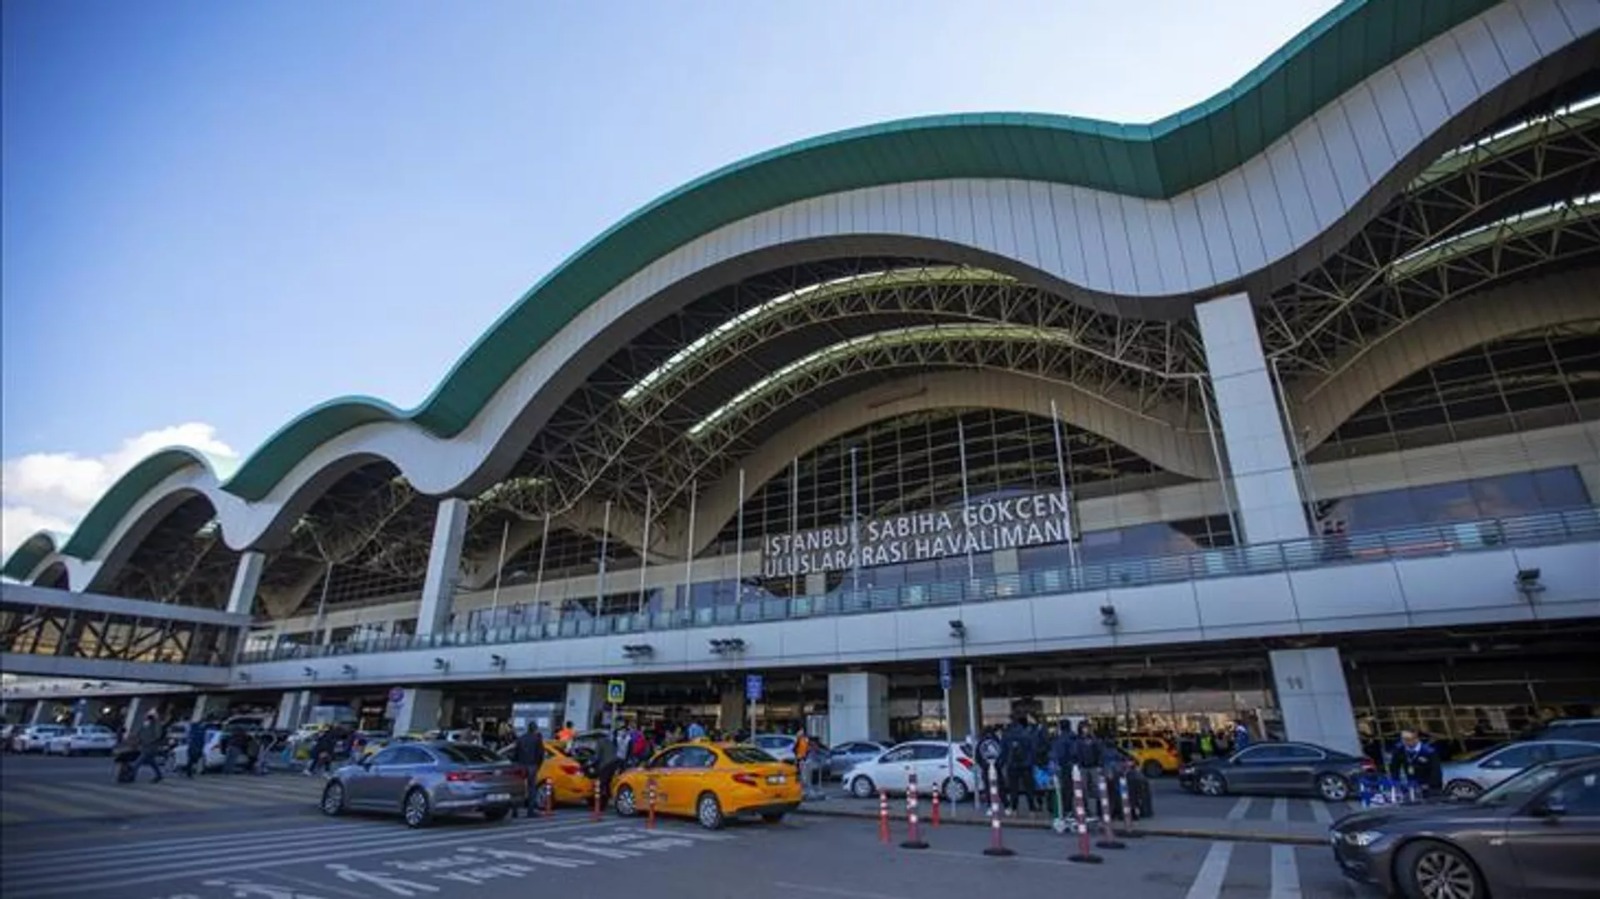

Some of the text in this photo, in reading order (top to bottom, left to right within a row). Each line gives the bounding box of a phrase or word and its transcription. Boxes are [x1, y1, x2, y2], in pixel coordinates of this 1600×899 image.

[764, 508, 1069, 578] ULUSLARARASI HAVALİMANI
[868, 511, 953, 542] SABİHA
[963, 493, 1068, 527] GÖKÇEN
